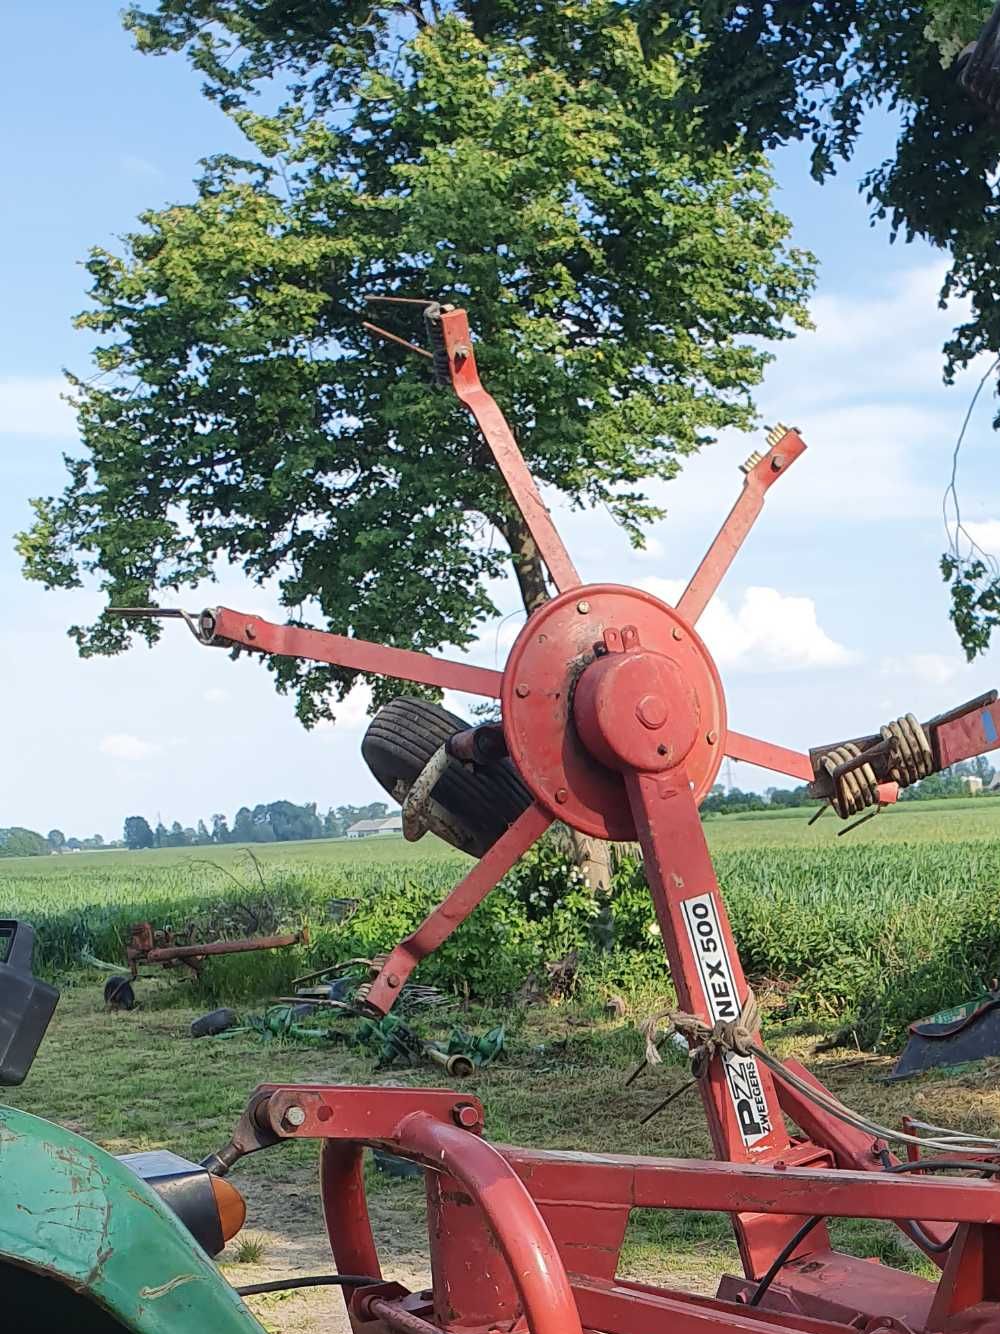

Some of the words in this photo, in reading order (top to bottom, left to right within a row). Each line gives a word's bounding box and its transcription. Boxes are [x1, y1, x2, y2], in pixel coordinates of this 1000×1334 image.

[692, 903, 718, 953] 500
[726, 1062, 762, 1136] PZ
[746, 1061, 771, 1133] ZWEEGERS
